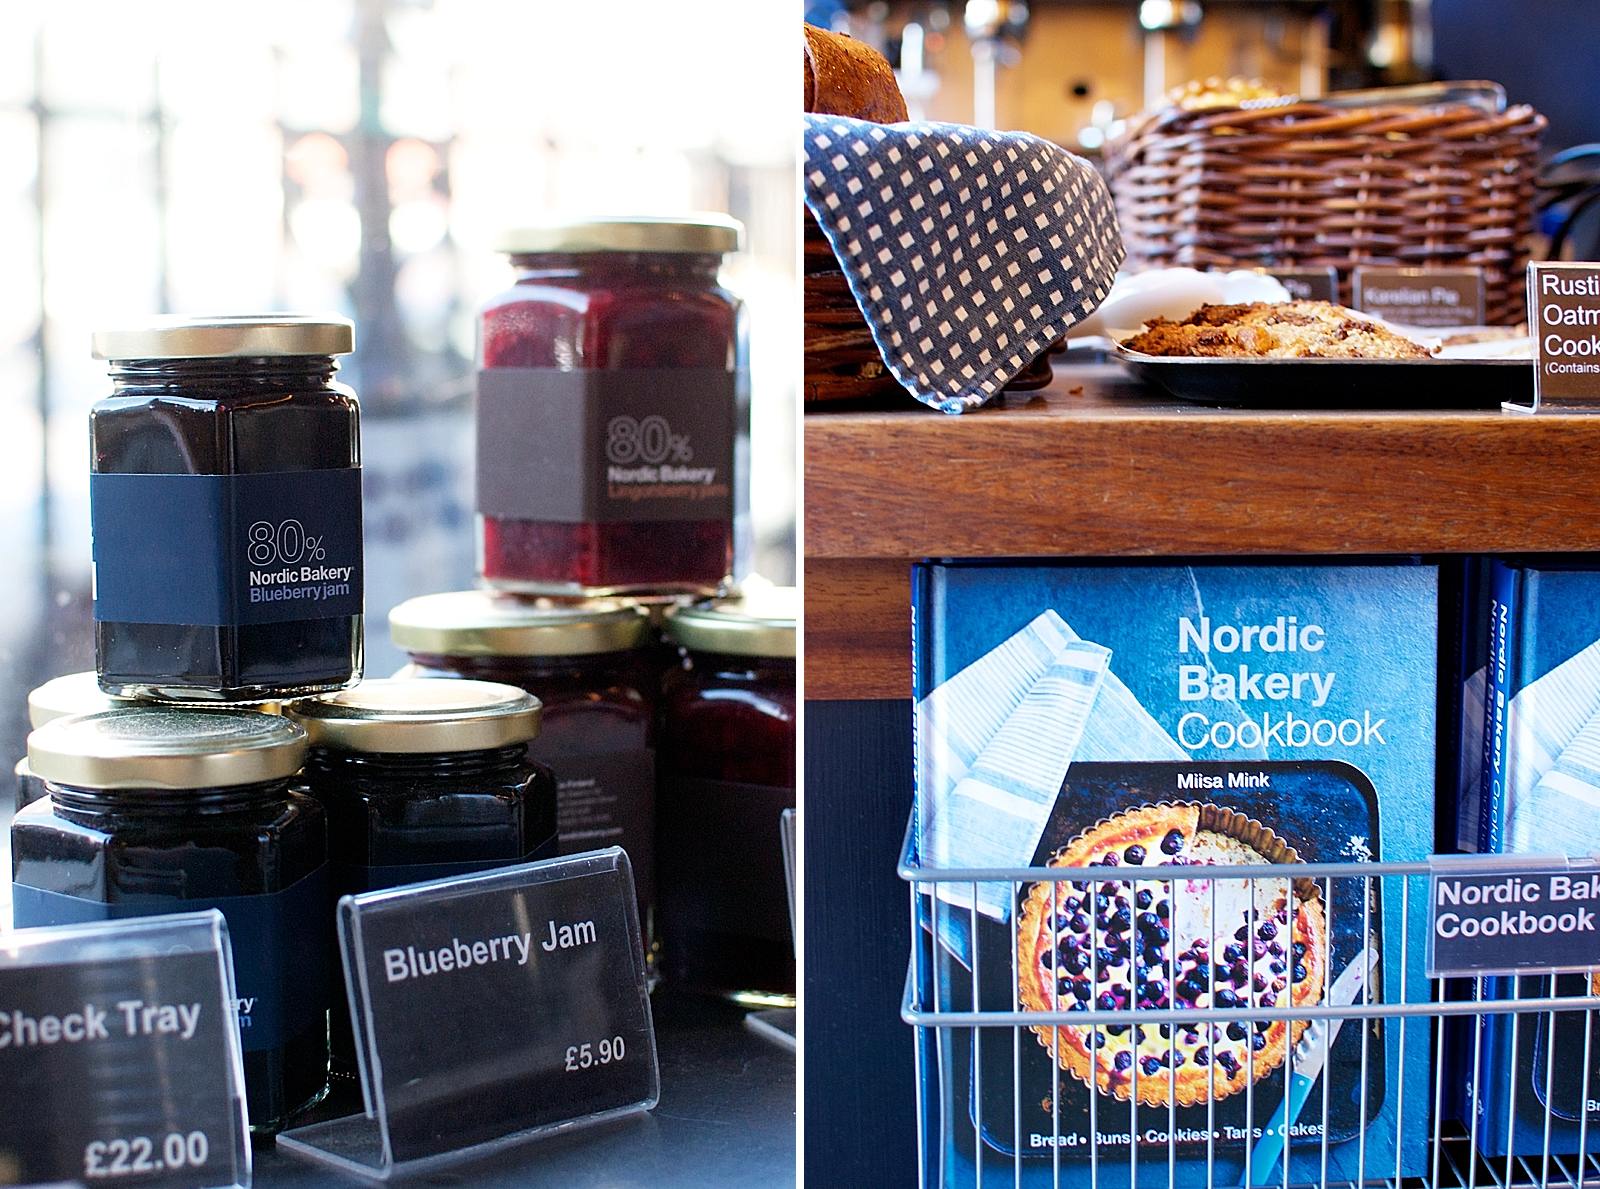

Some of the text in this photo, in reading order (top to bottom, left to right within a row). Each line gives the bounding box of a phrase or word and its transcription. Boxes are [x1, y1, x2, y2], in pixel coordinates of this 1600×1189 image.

[1542, 274, 1600, 296] Rusti
[605, 414, 695, 463] 80%
[607, 464, 716, 485] Nordic Bakery
[247, 519, 326, 567] 80%
[249, 565, 352, 587] Nordic Bakery
[250, 582, 350, 603] Blueberry jam
[1178, 616, 1326, 653] Nordic
[1497, 604, 1508, 684] Nordic
[1178, 664, 1336, 707] Bakery
[1177, 710, 1387, 749] Cookbook
[1493, 690, 1505, 775] Bakery
[1177, 772, 1271, 789] Miisa Mink
[1438, 878, 1541, 906] Nordic
[1436, 907, 1596, 938] Cookbook
[384, 920, 597, 983] Blueberry Jam
[117, 1000, 201, 1039] Tray
[564, 1036, 625, 1071] £5.90
[1223, 1125, 1262, 1139] Tars
[85, 1131, 209, 1177] £22.00
